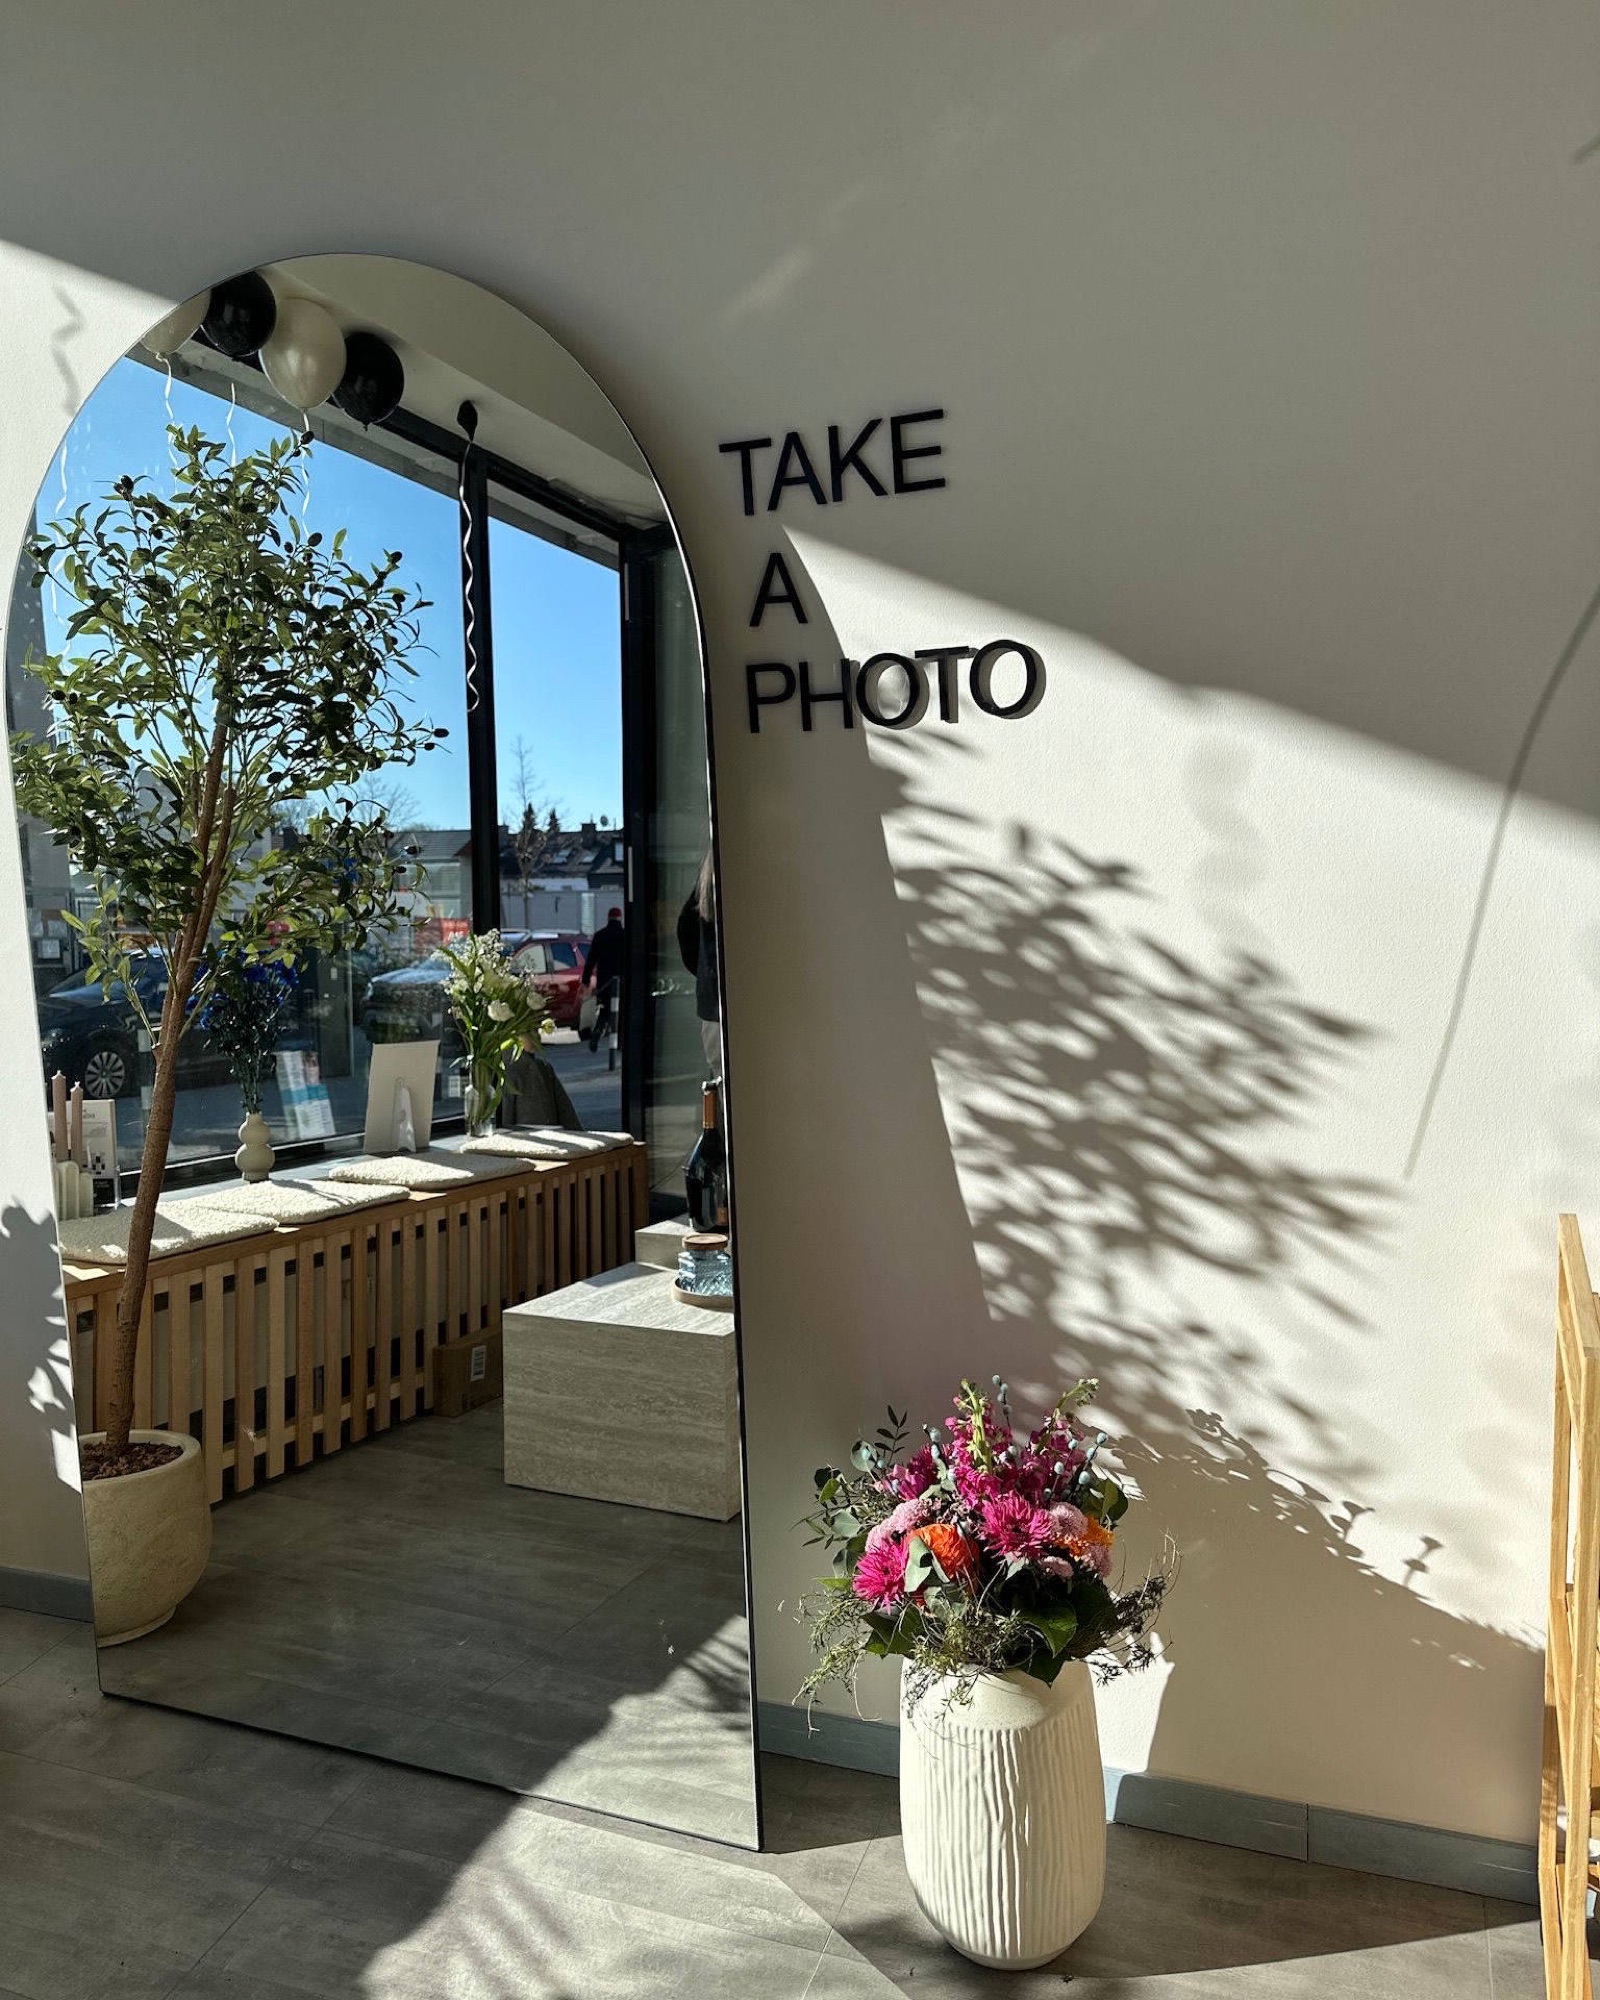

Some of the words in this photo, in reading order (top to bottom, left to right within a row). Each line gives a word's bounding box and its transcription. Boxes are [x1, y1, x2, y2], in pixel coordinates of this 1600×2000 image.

[719, 408, 946, 516] TAKE
[749, 552, 808, 627] A
[745, 639, 1039, 734] PHOTO
